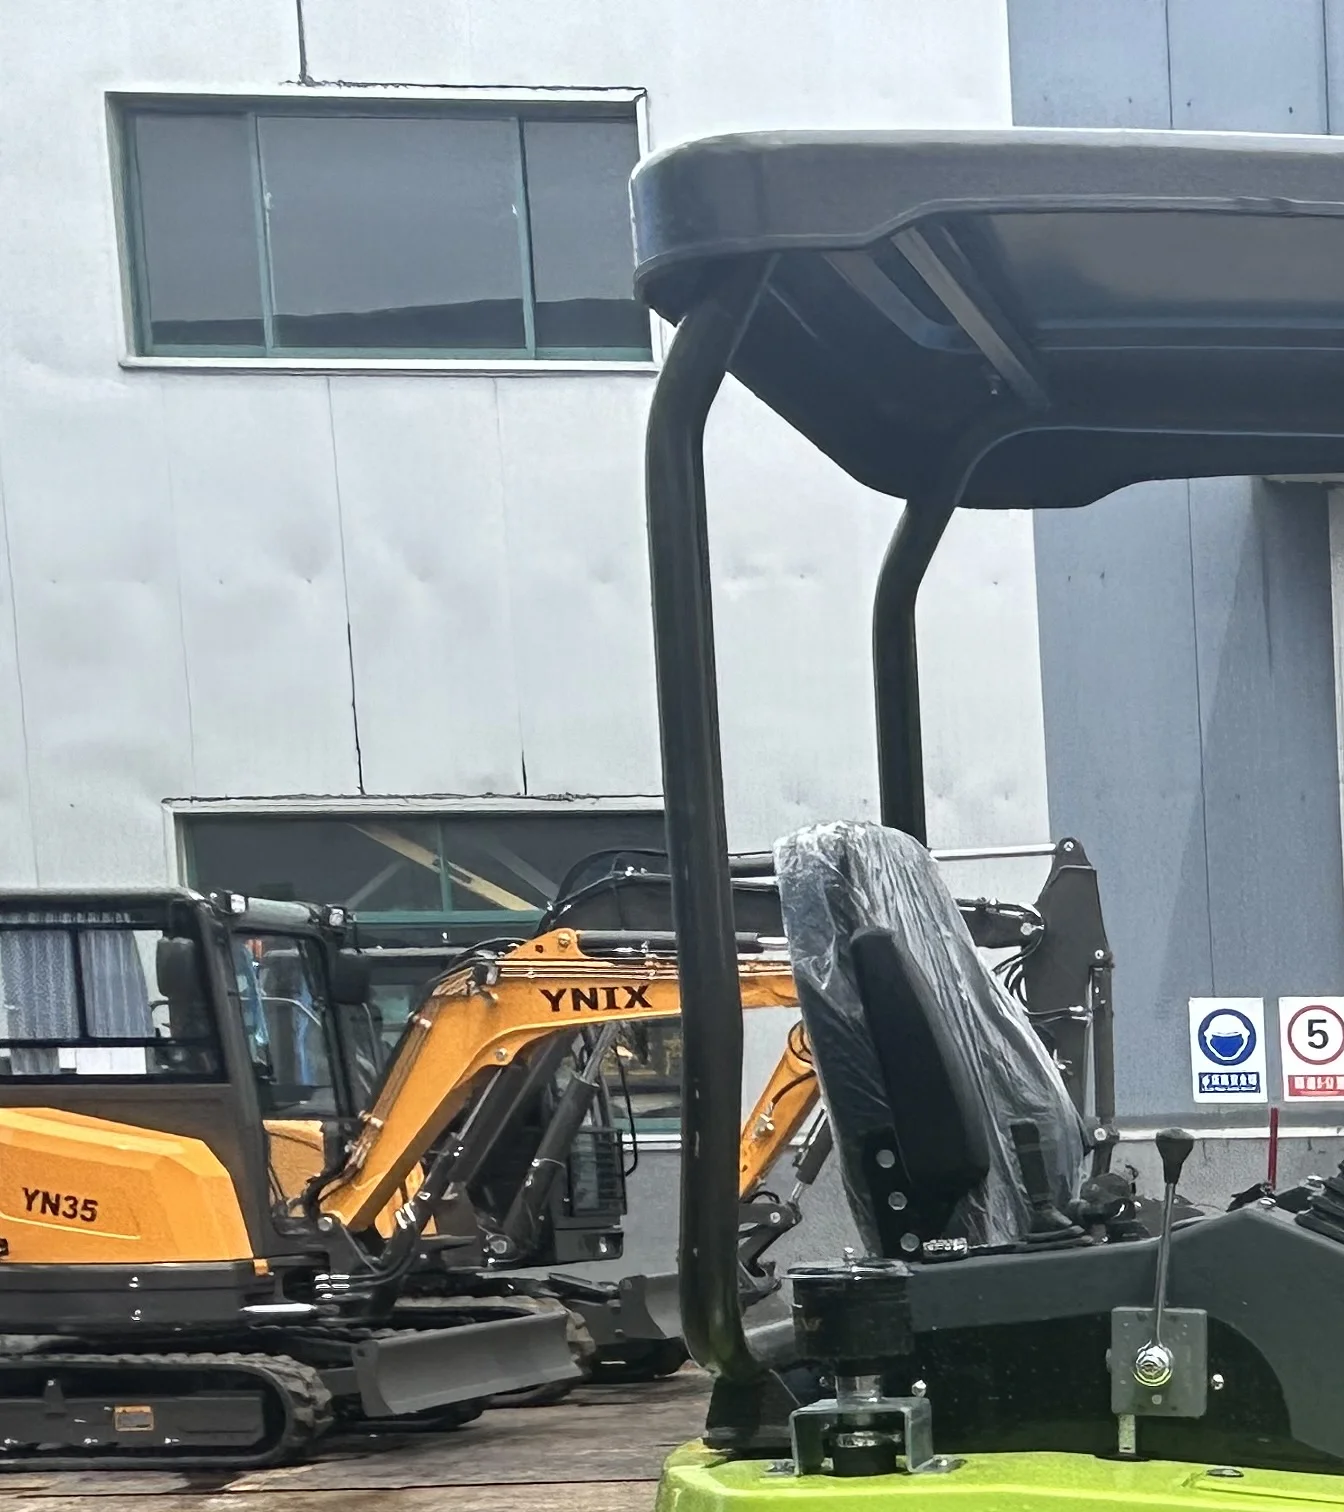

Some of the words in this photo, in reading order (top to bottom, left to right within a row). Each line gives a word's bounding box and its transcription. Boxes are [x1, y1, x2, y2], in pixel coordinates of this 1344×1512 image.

[539, 985, 653, 1012] YNIX
[1307, 1019, 1329, 1049] 5
[22, 1187, 98, 1222] YN35
